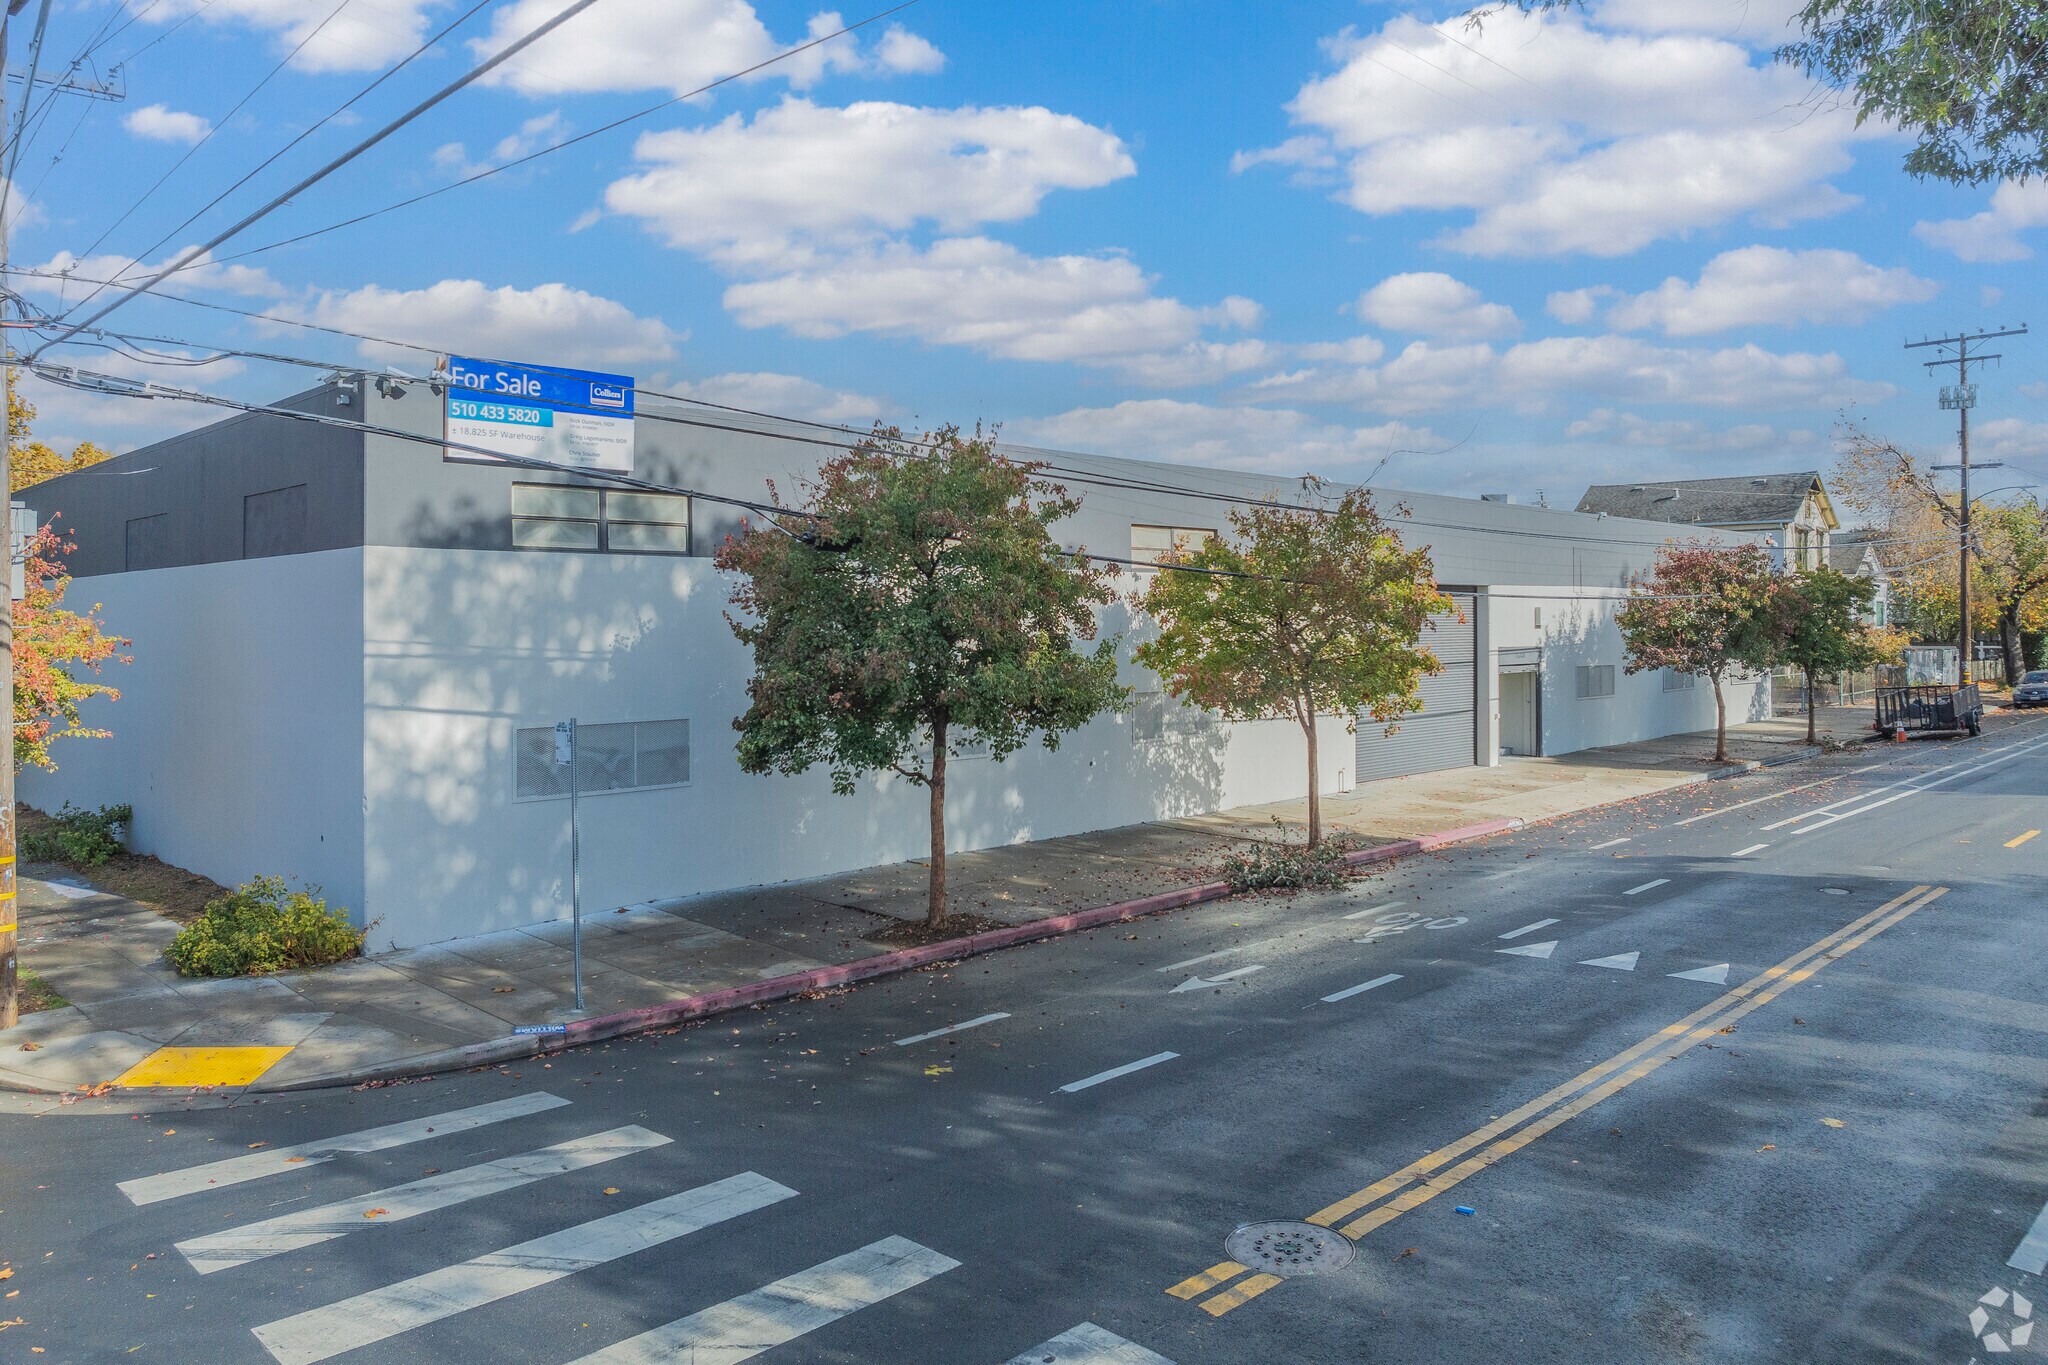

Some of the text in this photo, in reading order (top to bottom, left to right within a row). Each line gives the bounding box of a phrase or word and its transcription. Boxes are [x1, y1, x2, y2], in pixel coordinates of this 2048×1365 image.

[452, 366, 541, 396] For Sale
[594, 387, 621, 399] Colliers
[452, 402, 540, 423] 510 433 5820
[459, 427, 487, 437] 18,825
[489, 429, 499, 438] SF
[500, 431, 546, 442] Warehouse
